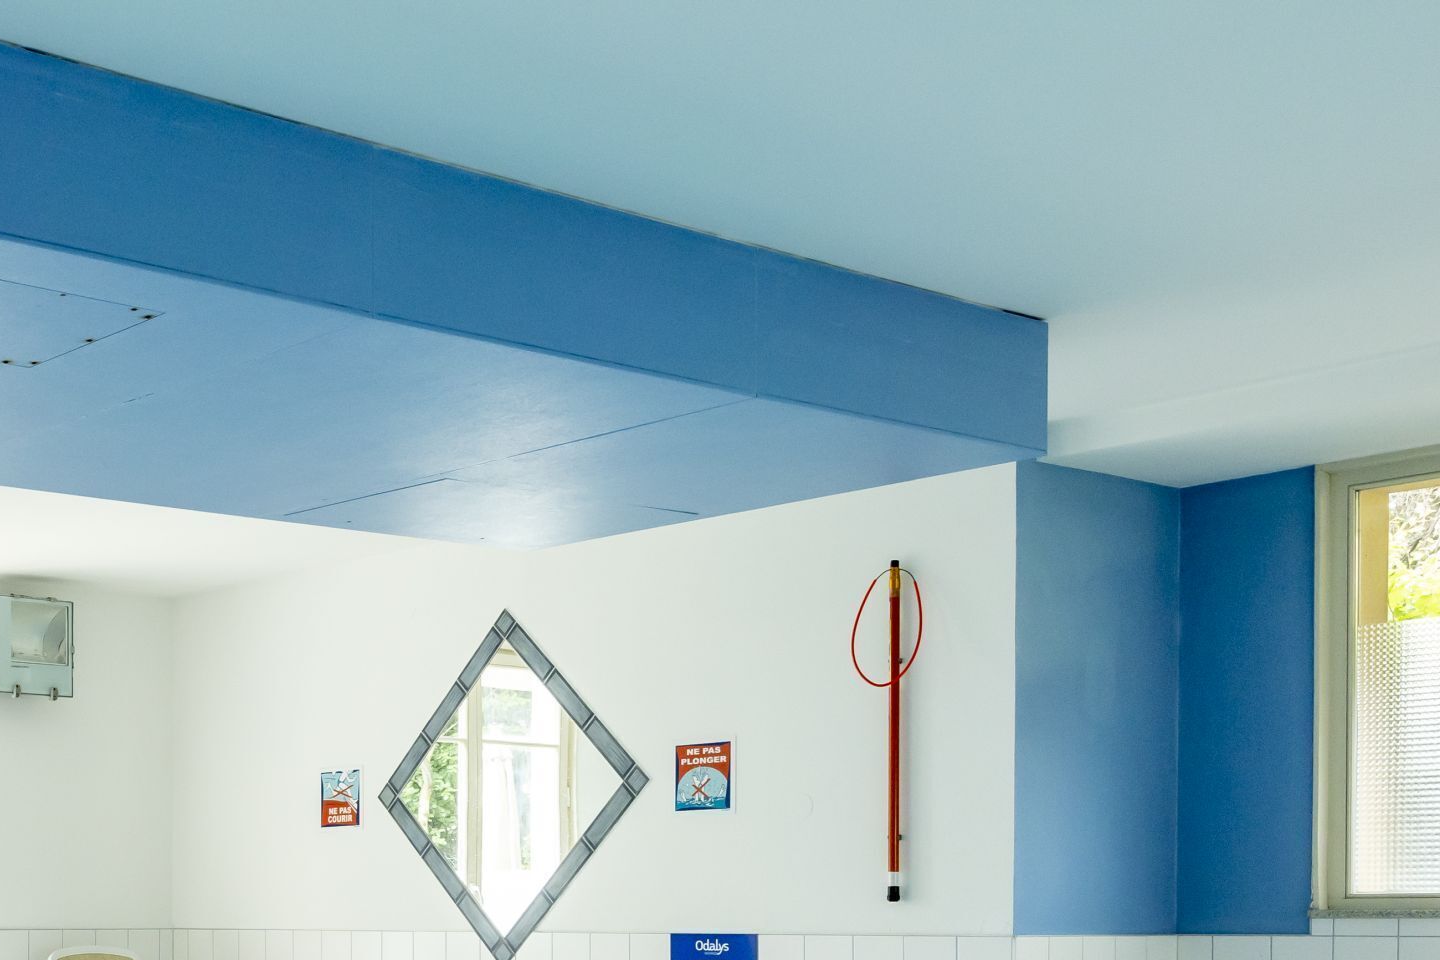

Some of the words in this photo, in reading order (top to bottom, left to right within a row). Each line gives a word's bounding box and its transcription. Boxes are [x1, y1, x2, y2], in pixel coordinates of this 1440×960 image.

[686, 748, 700, 756] NE
[702, 746, 721, 754] PAS
[680, 755, 727, 766] PLONGER
[328, 807, 338, 815] NE
[339, 806, 352, 814] PAS
[327, 814, 353, 823] COURIR
[695, 938, 730, 955] Odalys
